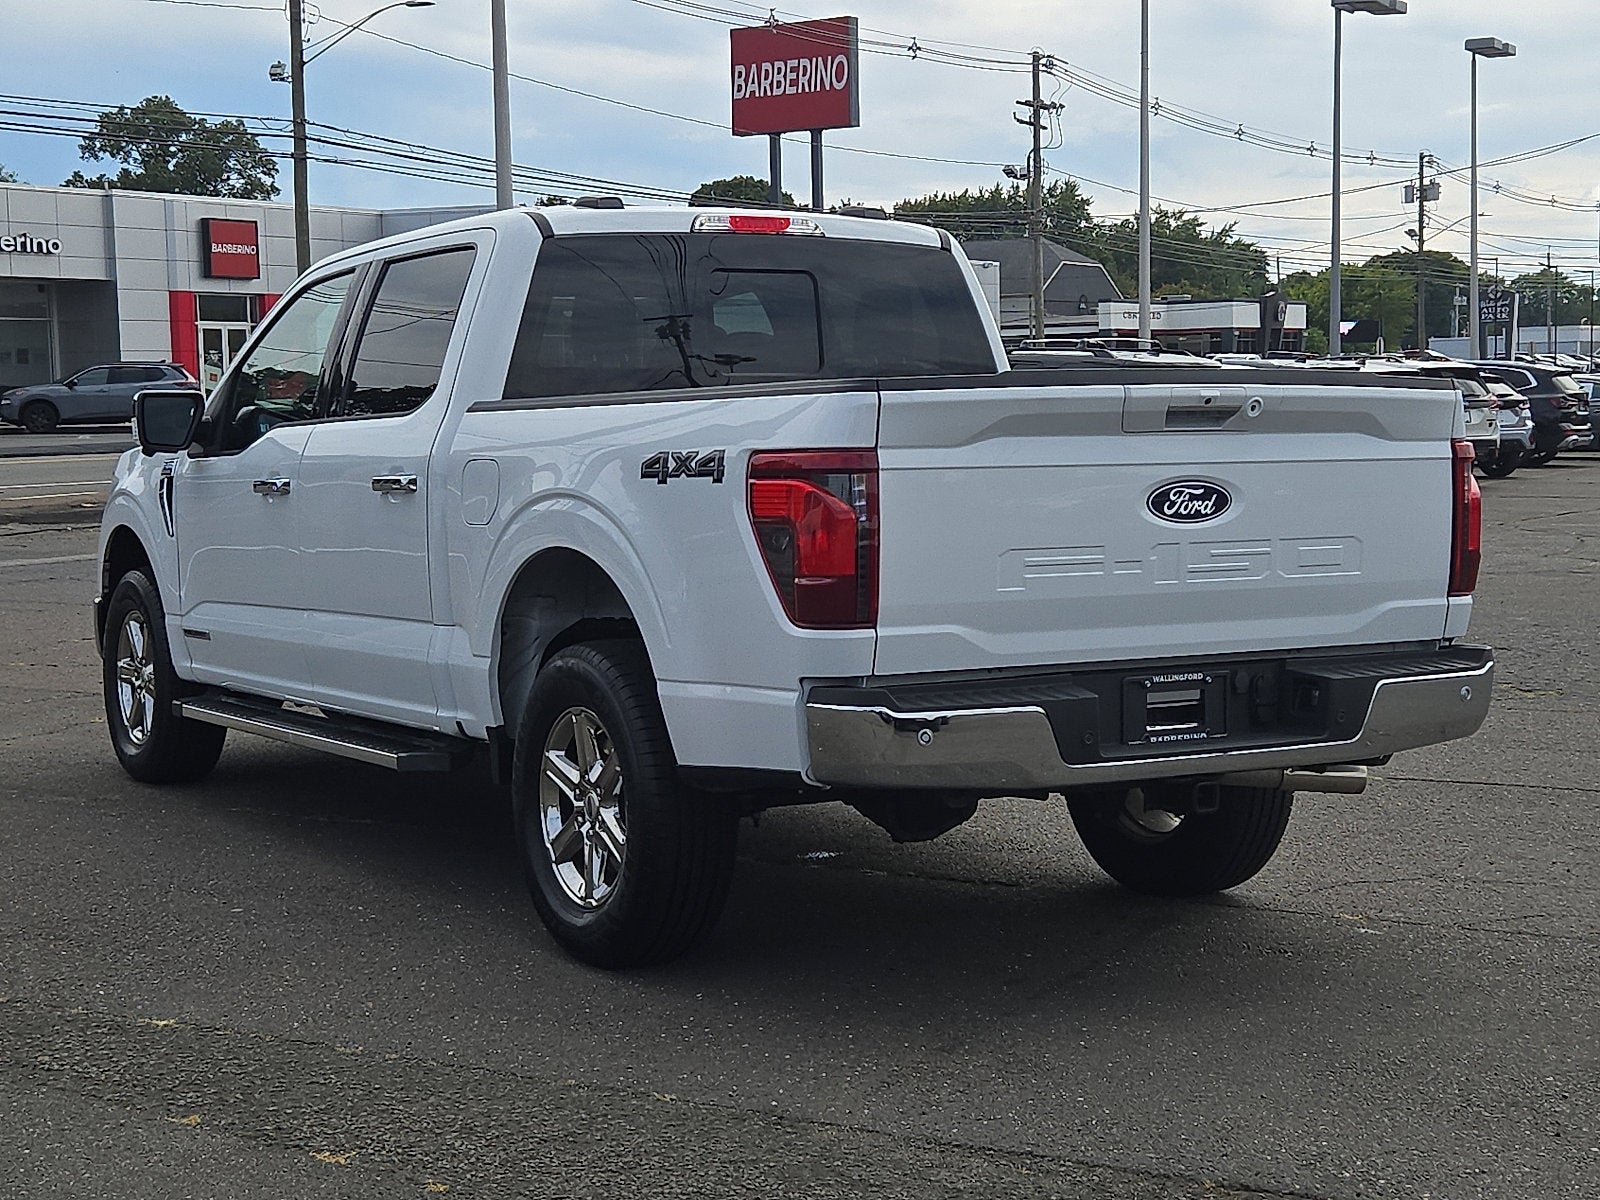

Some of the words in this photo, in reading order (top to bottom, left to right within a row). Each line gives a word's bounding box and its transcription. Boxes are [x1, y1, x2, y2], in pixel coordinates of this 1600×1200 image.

[733, 54, 849, 99] BARBERINO
[0, 233, 62, 254] erino
[211, 242, 257, 255] BARBERINO
[1481, 306, 1510, 314] AUTO
[1163, 487, 1216, 516] Ford
[996, 535, 1362, 592] F-150
[1152, 672, 1204, 683] WALLINGFORD
